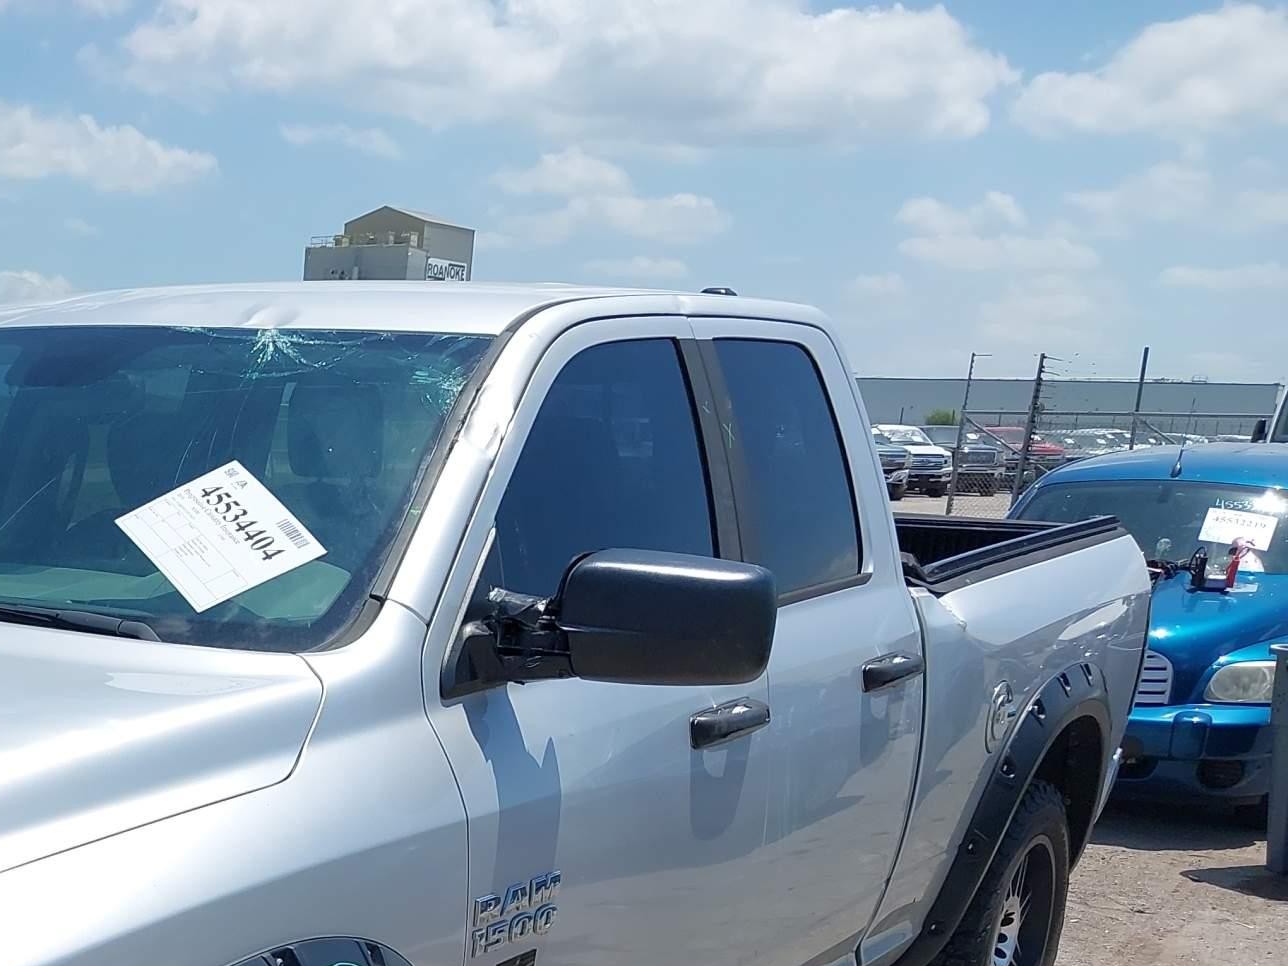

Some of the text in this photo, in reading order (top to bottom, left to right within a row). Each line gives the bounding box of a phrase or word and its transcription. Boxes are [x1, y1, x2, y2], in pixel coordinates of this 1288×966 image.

[427, 262, 465, 280] ROANOKE
[201, 486, 286, 561] 45534404
[473, 870, 561, 927] RAM
[472, 902, 559, 958] 1500
